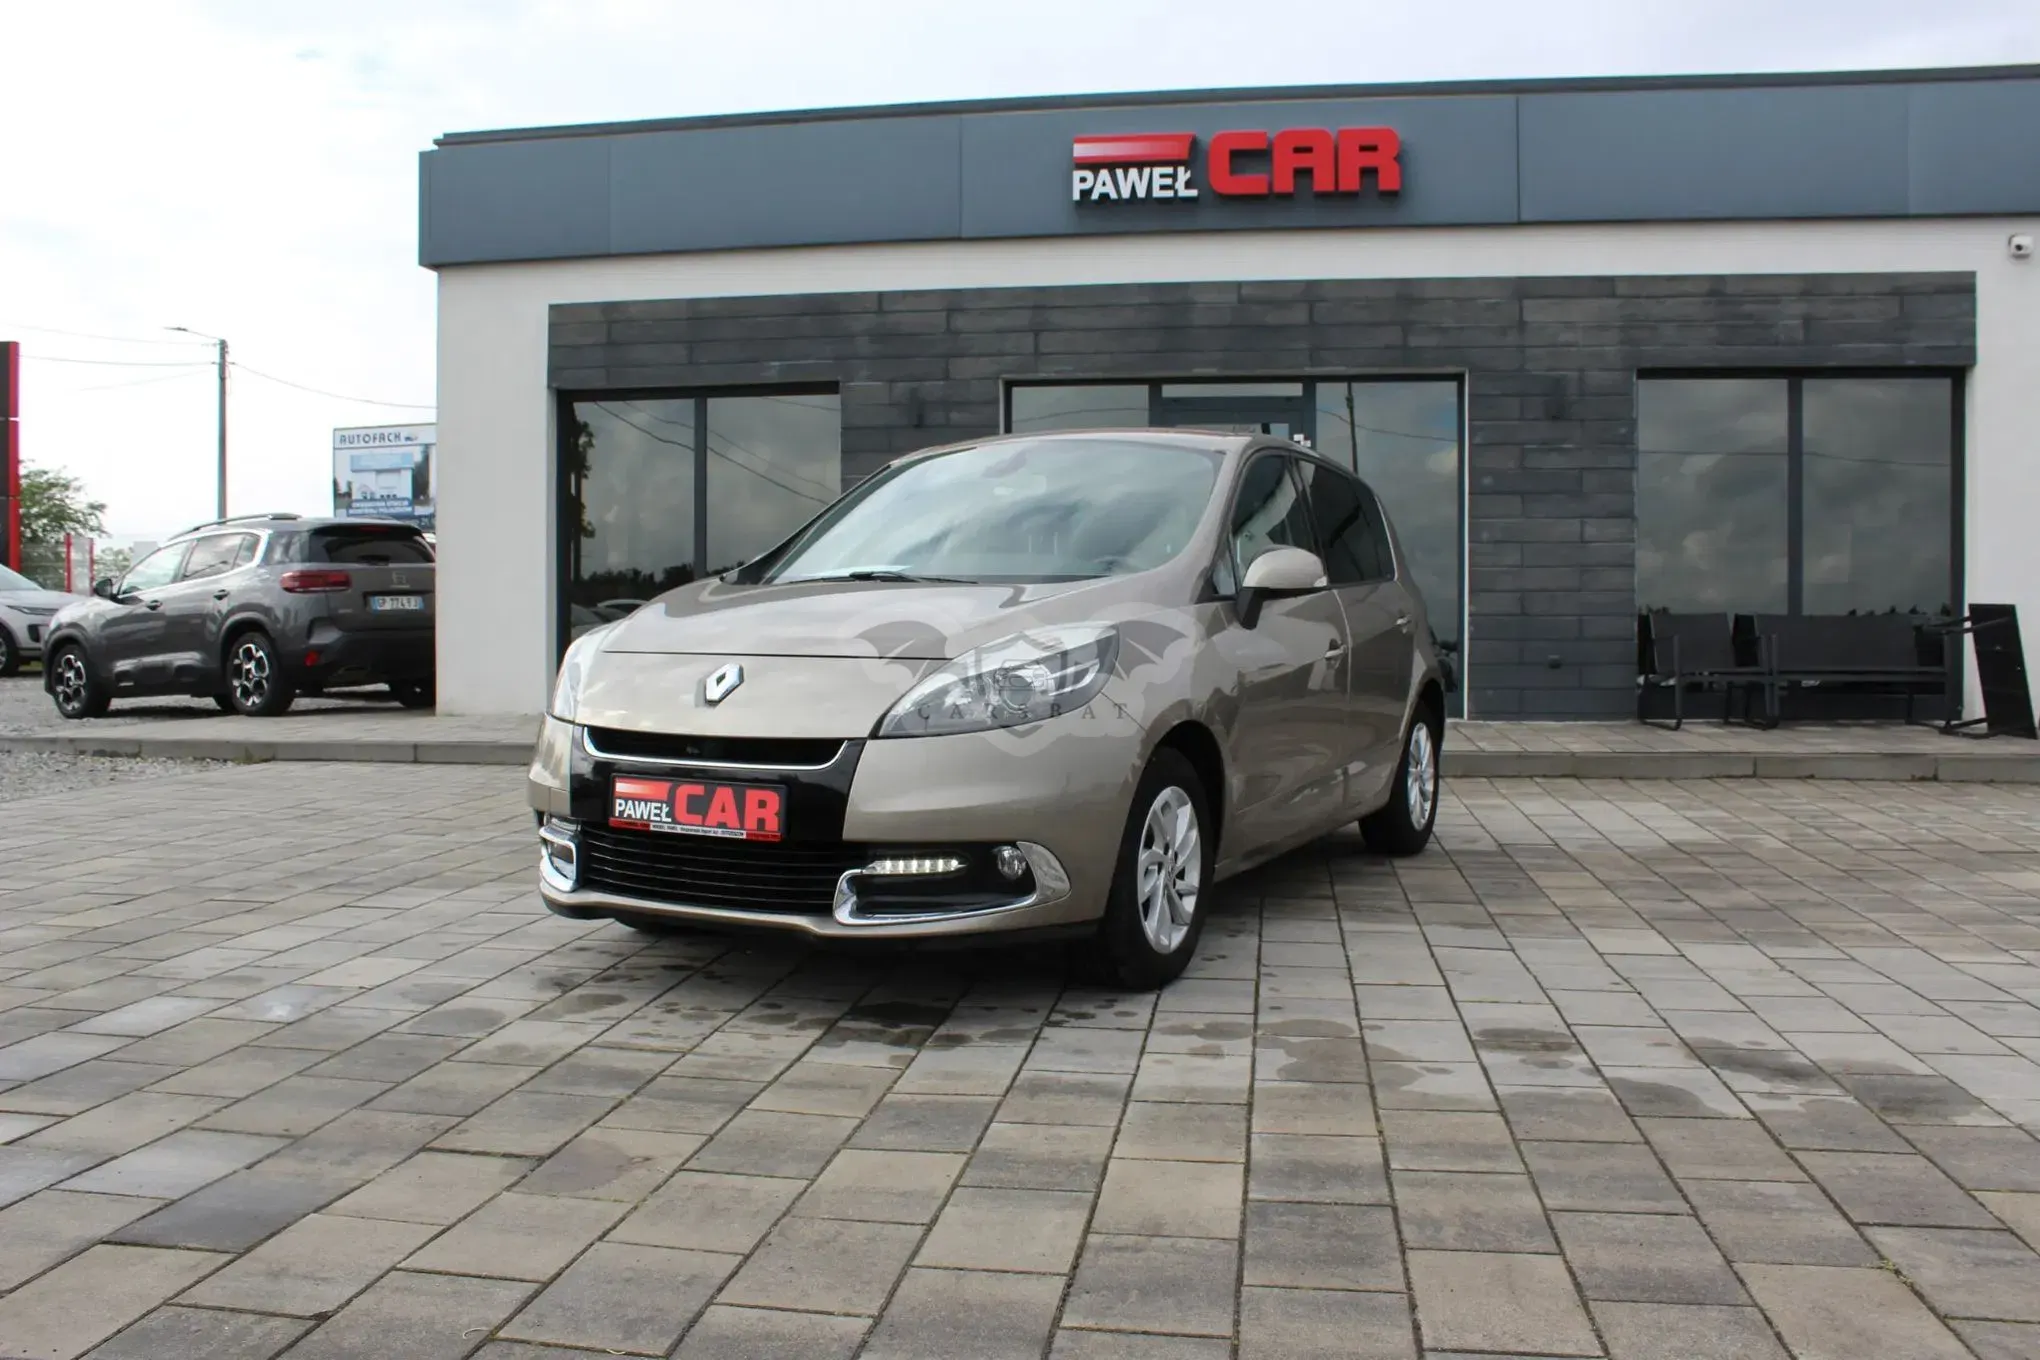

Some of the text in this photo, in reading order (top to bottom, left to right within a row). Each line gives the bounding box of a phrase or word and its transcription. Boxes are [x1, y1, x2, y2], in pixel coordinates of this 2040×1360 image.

[1073, 127, 1401, 200] PAWEŁ CAR
[615, 784, 781, 832] PAWEŁ CAR
